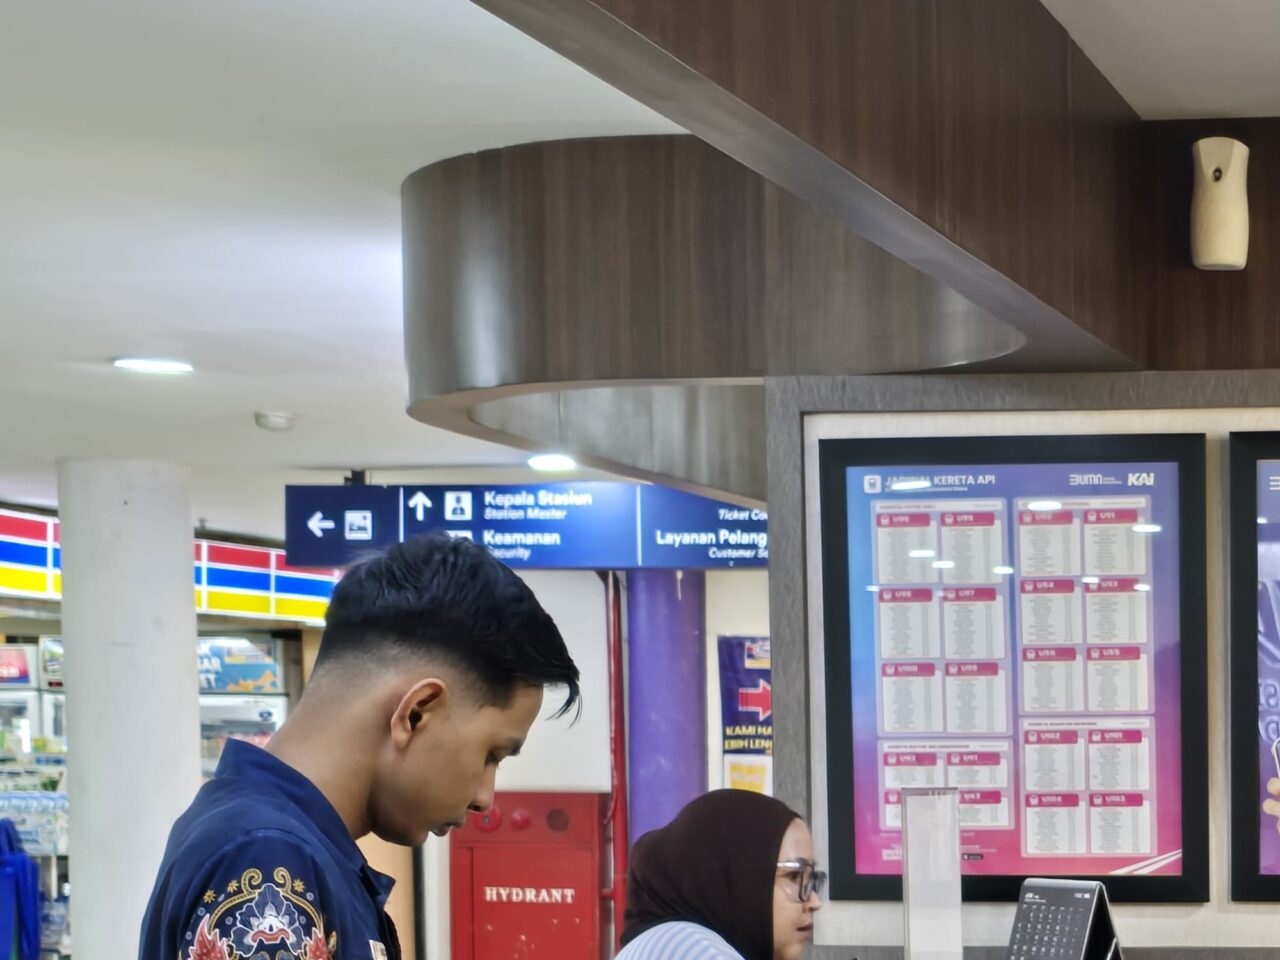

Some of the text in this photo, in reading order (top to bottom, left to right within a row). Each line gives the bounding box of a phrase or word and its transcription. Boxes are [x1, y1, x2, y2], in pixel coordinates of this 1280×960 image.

[934, 476, 974, 484] KERETA
[978, 475, 995, 484] API
[1128, 473, 1154, 486] KAI
[483, 491, 592, 507] Kepala Stasiun
[483, 509, 567, 520] Station Master
[718, 509, 749, 520] Ticket
[483, 531, 560, 544] Keamanan
[656, 530, 767, 546] Layanan Pelang
[709, 547, 756, 558] Customer
[485, 886, 575, 904] HYDRANT
